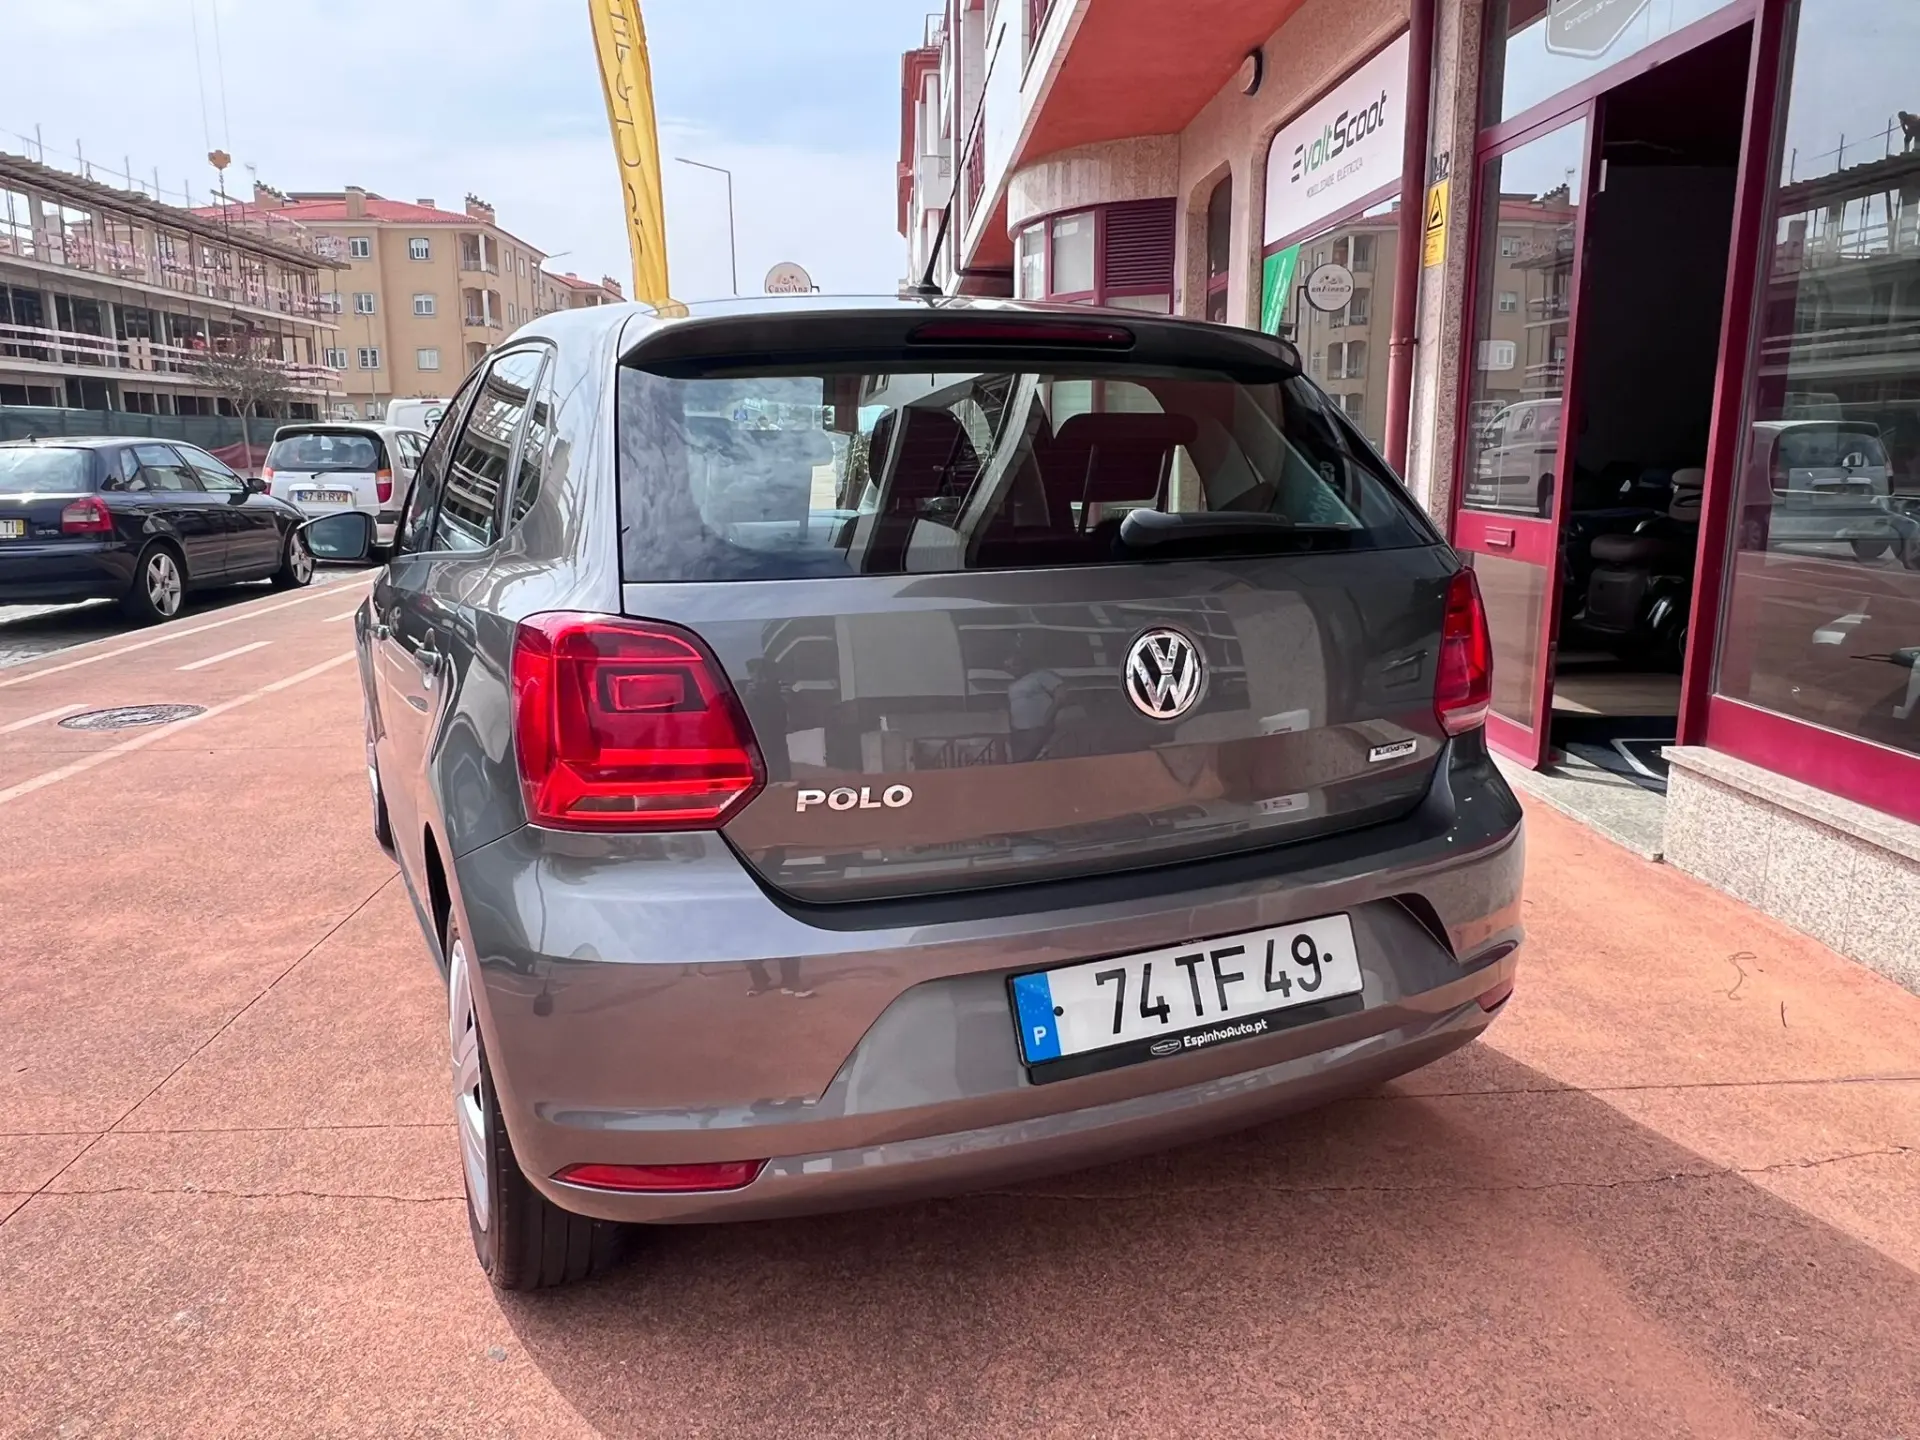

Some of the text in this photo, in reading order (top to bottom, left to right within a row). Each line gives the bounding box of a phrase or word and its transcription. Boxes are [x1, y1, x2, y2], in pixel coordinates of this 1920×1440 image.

[796, 784, 913, 812] POLO
[1265, 933, 1323, 998] 49
[1032, 1025, 1048, 1046] P
[1183, 1018, 1269, 1047] EspinhoAuto.pt
